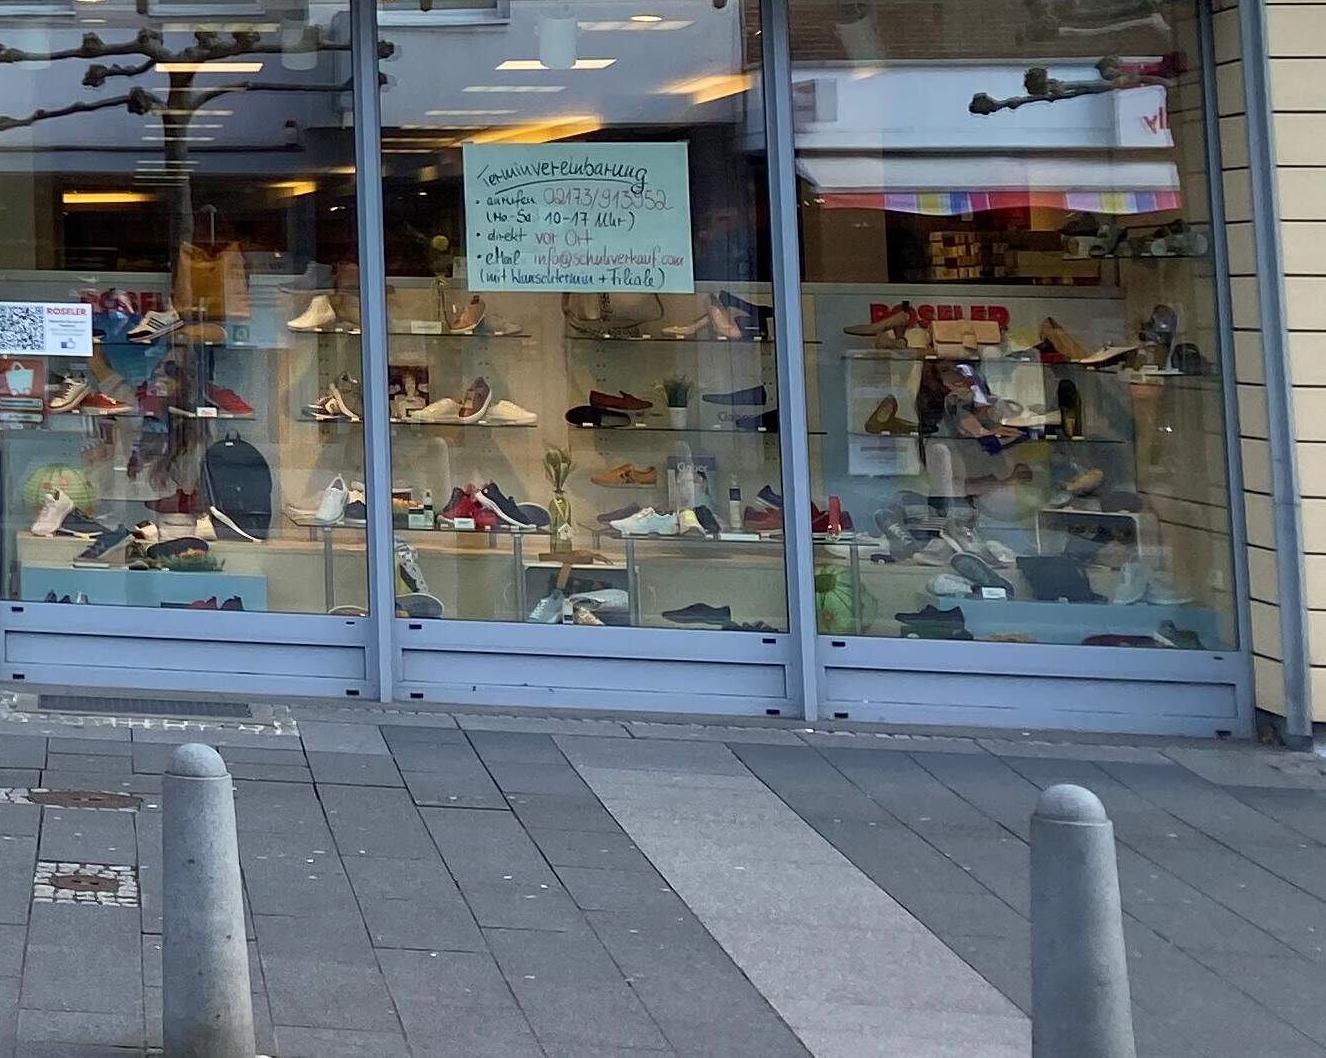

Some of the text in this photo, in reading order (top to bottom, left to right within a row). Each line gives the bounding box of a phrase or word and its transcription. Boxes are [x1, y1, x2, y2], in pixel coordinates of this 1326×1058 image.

[477, 156, 647, 194] Terminvereinbarung
[487, 190, 538, 208] anrufen
[487, 228, 595, 246] direkt vor Ort
